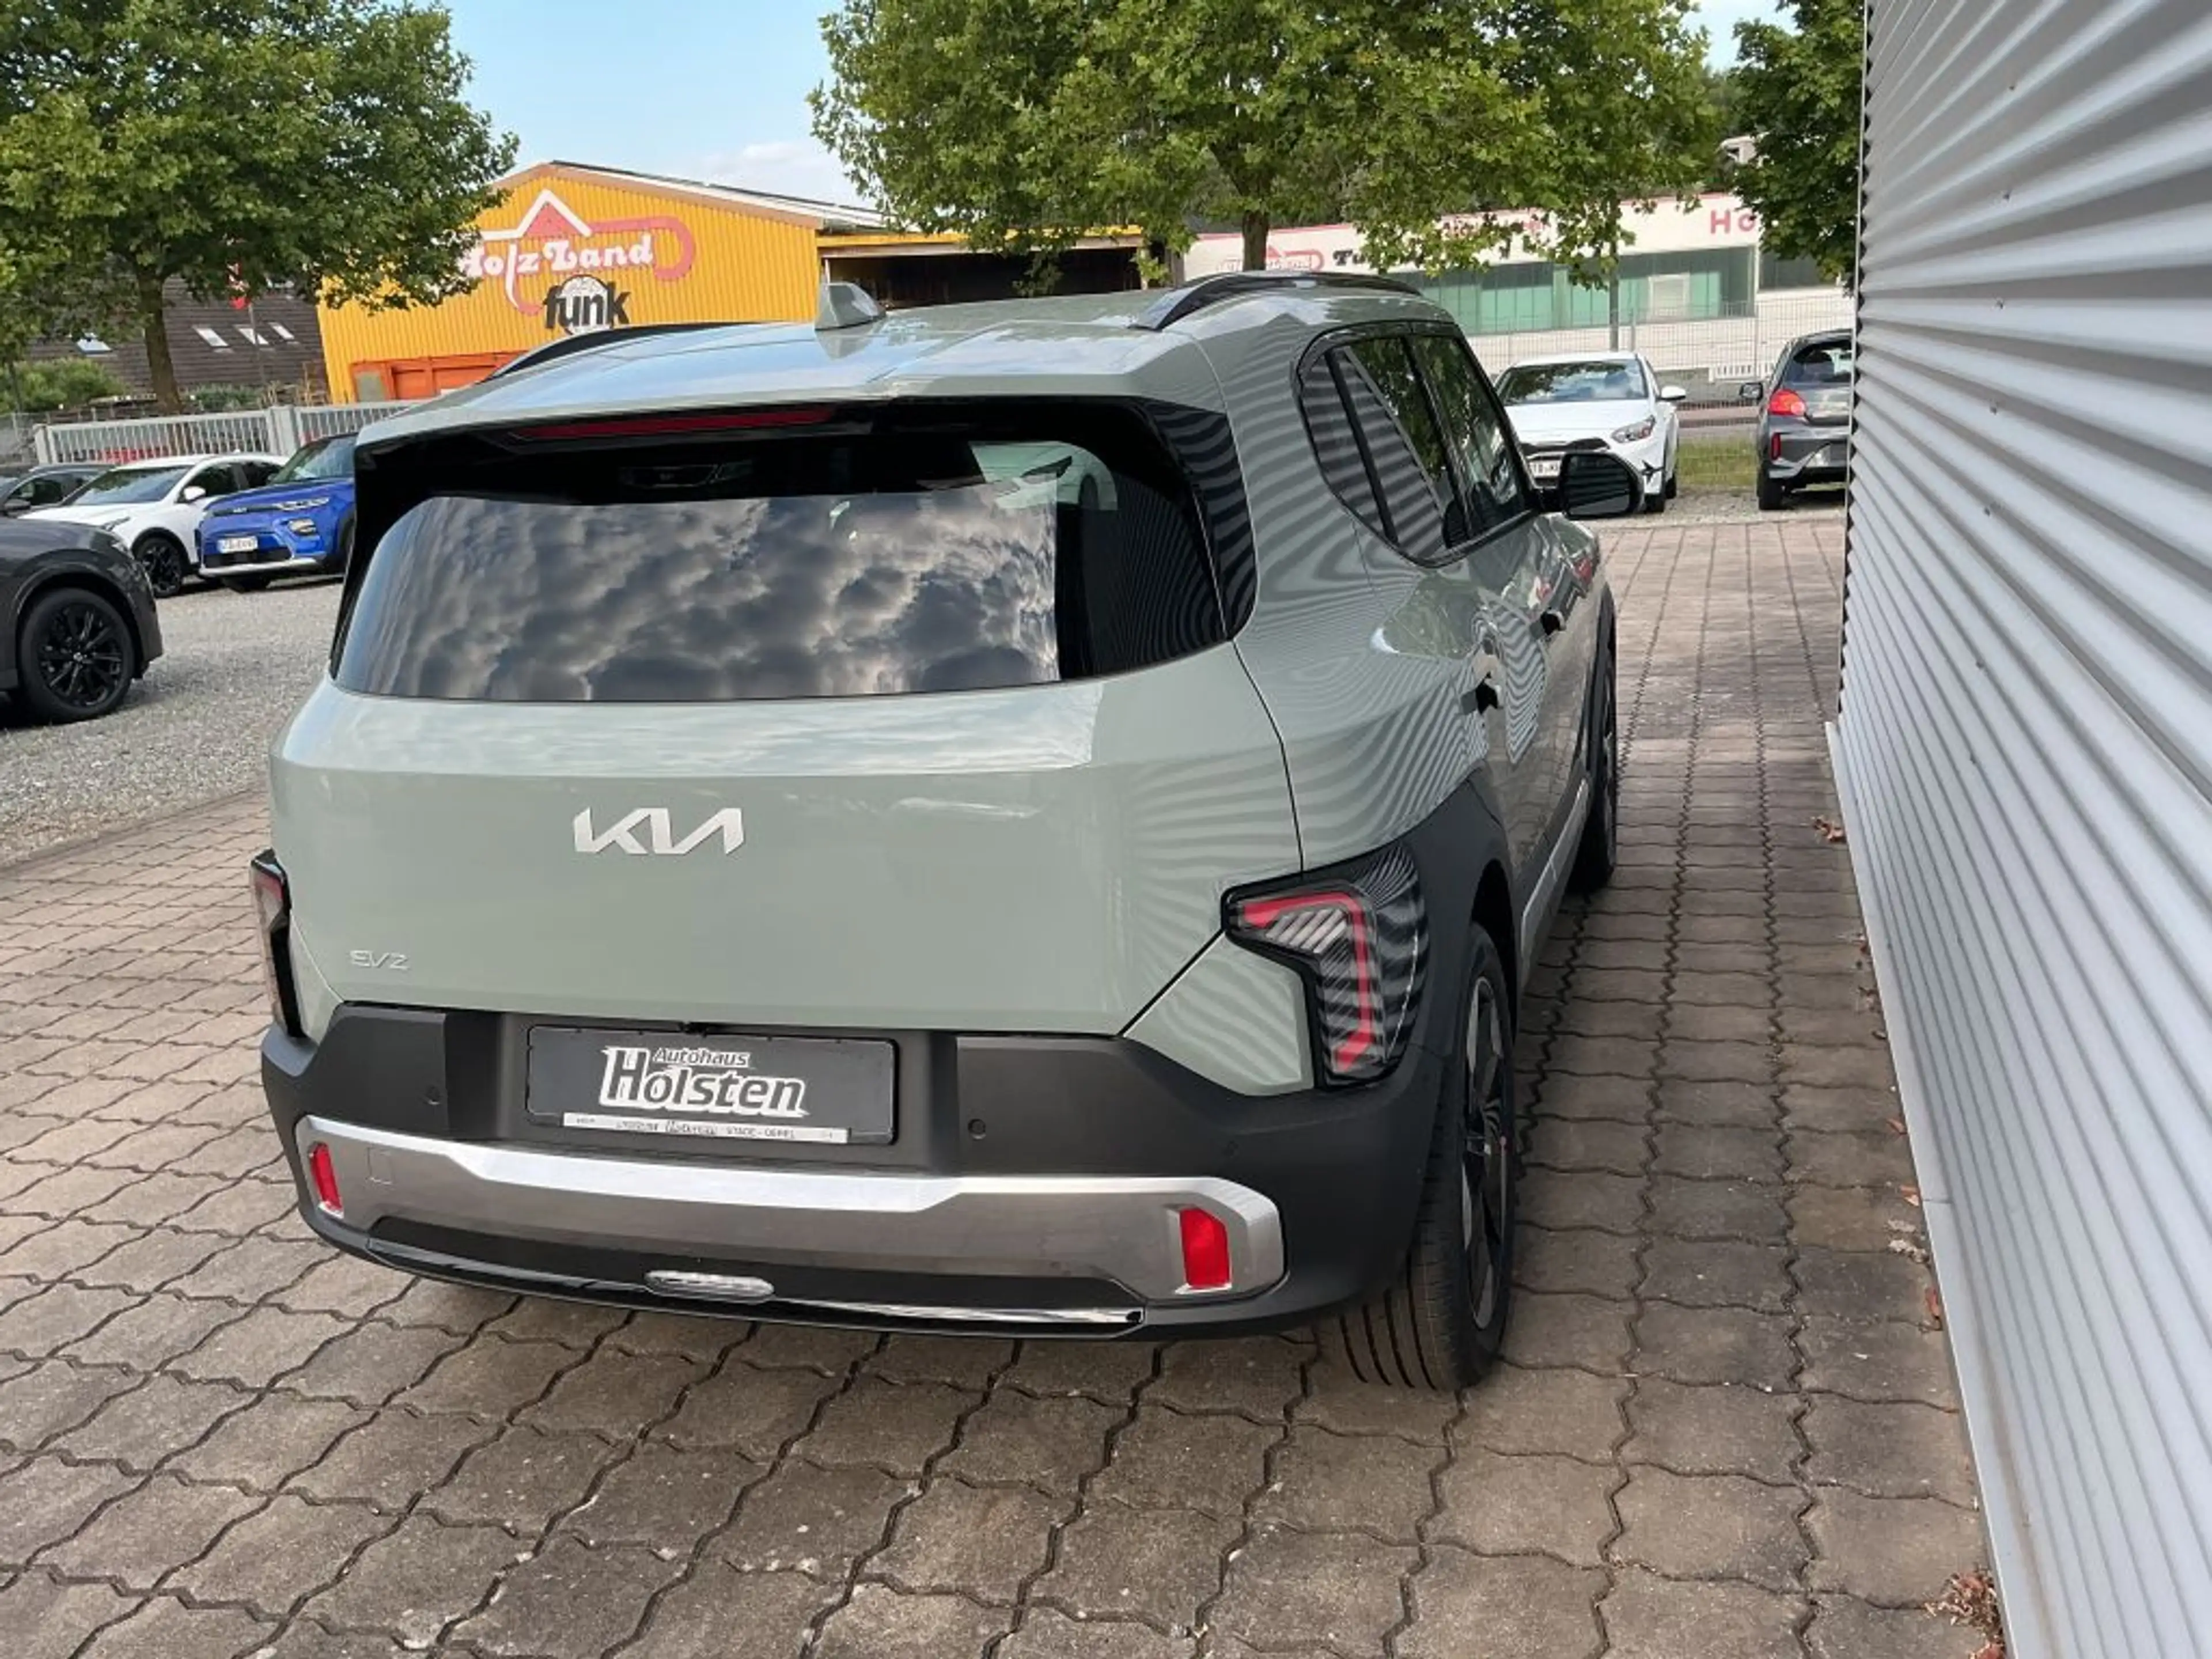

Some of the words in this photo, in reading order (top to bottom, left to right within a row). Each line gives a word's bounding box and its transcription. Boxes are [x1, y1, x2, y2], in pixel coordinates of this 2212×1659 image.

[542, 281, 631, 329] funk
[574, 807, 744, 855] KIA
[350, 950, 410, 969] EV2
[653, 1042, 749, 1066] Autohaus
[604, 1047, 805, 1113] Holsten
